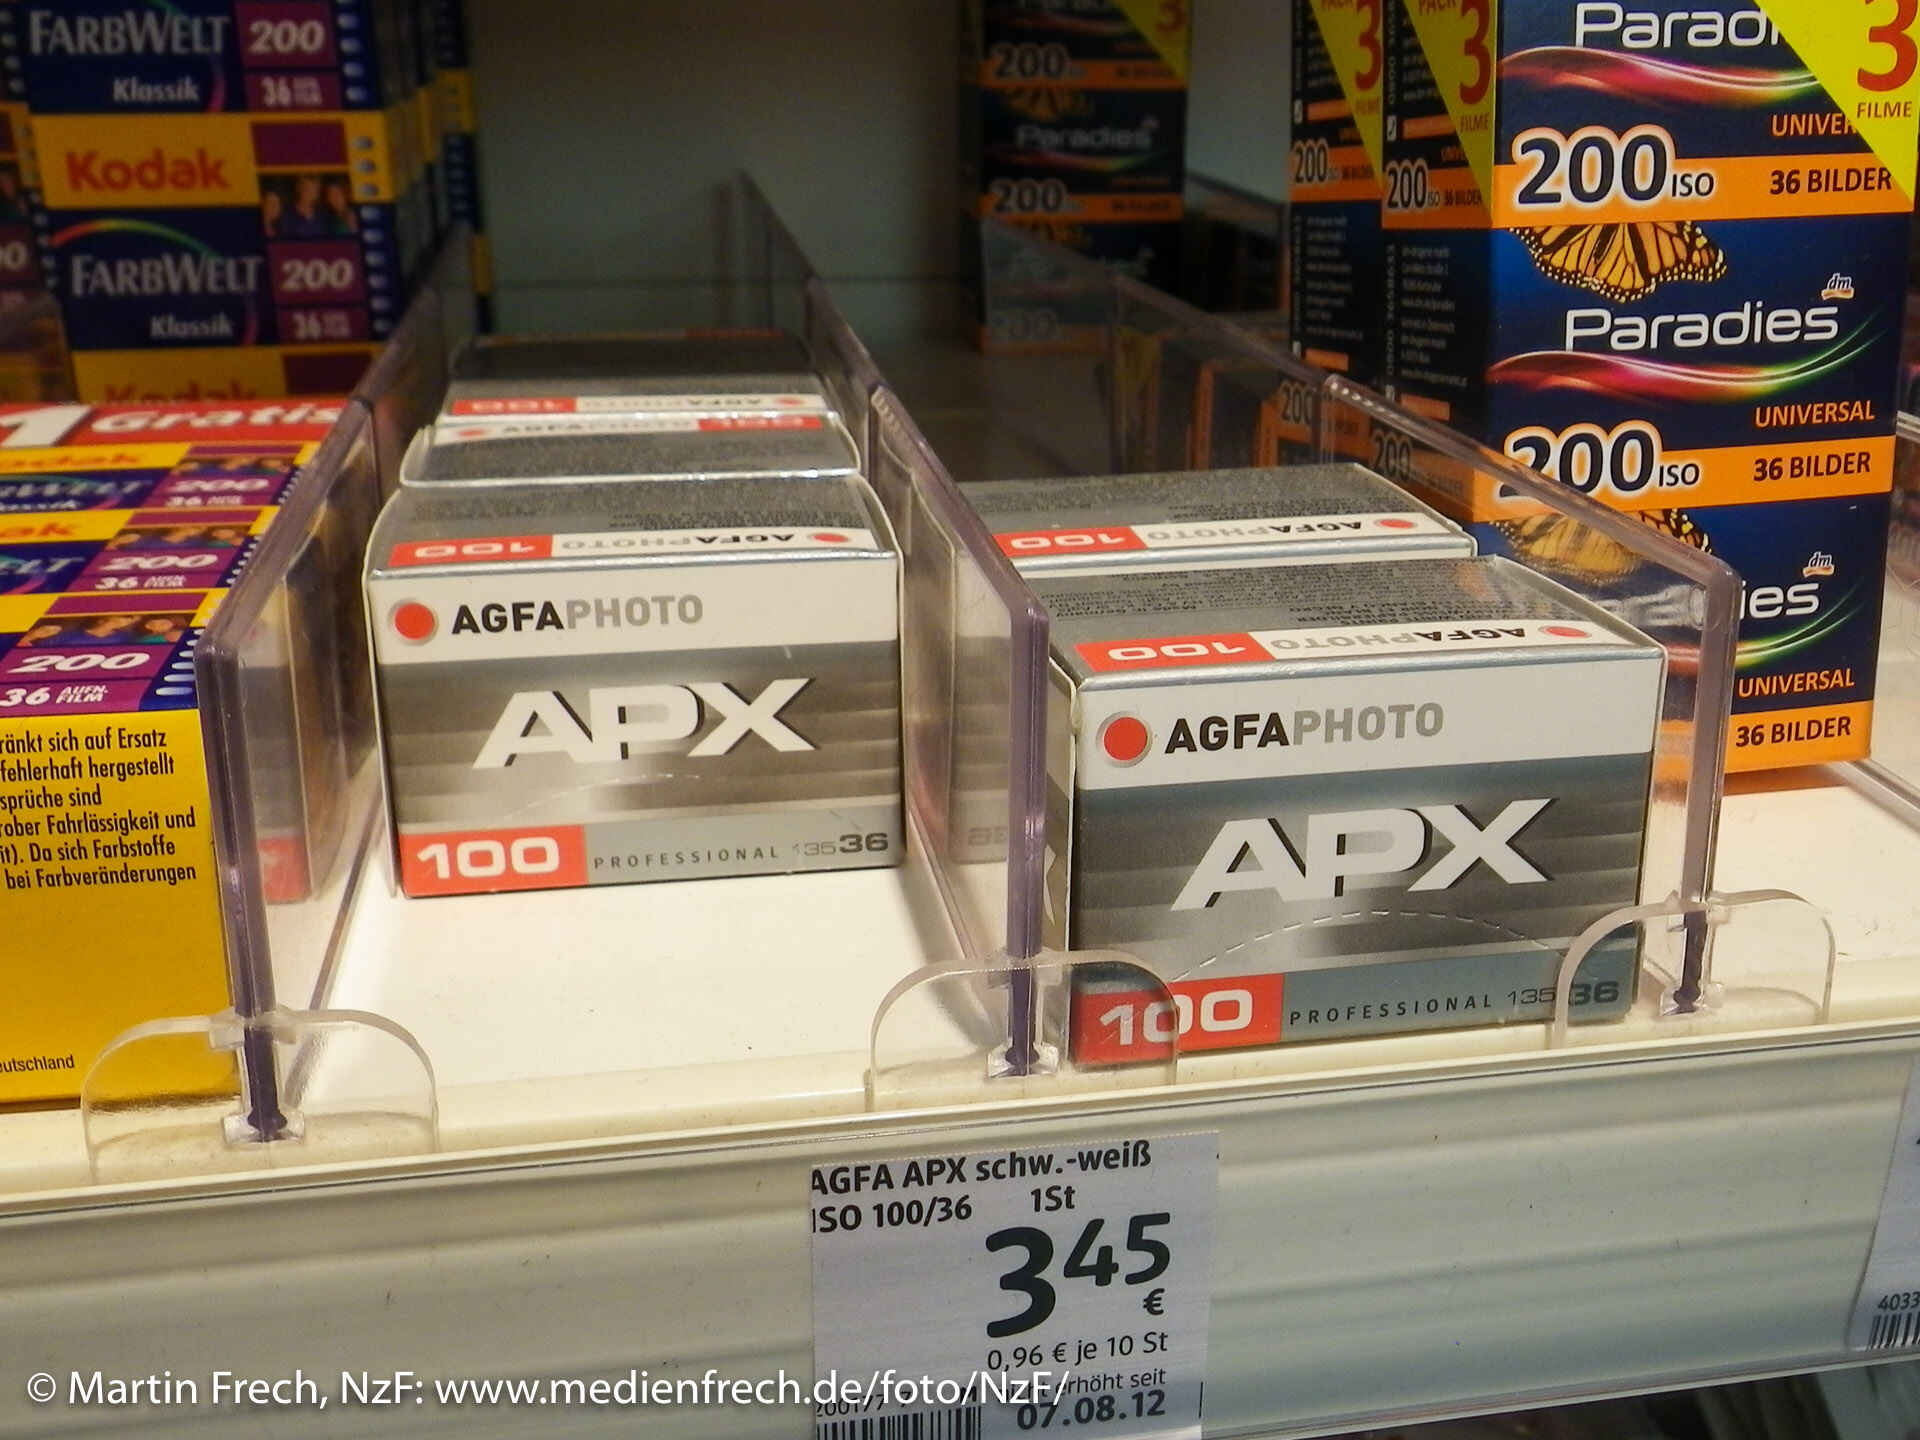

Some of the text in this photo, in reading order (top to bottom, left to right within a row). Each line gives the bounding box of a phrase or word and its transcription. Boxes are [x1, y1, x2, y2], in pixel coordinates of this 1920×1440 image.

[249, 19, 326, 54] 200
[1857, 0, 1918, 92] 3
[994, 49, 1067, 79] 200
[1459, 0, 1491, 105] 3
[113, 77, 199, 102] Klassik
[1857, 102, 1912, 119] FILME
[65, 148, 231, 192] Kodak
[1295, 144, 1328, 183] 200
[1517, 133, 1668, 204] 200
[1387, 164, 1428, 208] 200
[1671, 172, 1715, 198] ISO
[1769, 167, 1893, 195] 36 BILDER
[993, 183, 1064, 213] 200
[281, 258, 353, 290] 200
[150, 315, 233, 339] Klassik
[1565, 301, 1839, 352] Paradies
[91, 403, 344, 433] Gratis
[1755, 400, 1875, 428] UNIVERSAL
[1658, 462, 1700, 488] ISO
[1753, 452, 1871, 481] 36 BILDER
[414, 532, 794, 559] 100 AGFAPHOTO
[1011, 520, 1363, 550] 100 AGFAPHOTO
[101, 554, 218, 570] 200
[95, 576, 138, 590] 36
[452, 593, 703, 635] AGFAPHOTO
[1107, 627, 1526, 662] 100 AGFAPHOTO
[8, 653, 150, 673] 200
[4, 687, 51, 707] 36
[1738, 668, 1855, 697] UNIVERSAL
[472, 676, 822, 769] APX
[1165, 702, 1445, 756] AGFAPHOTO
[1735, 715, 1851, 747] 36 BILDER
[49, 728, 79, 752] sich
[85, 726, 112, 750] auf
[118, 728, 167, 750] Ersatz
[0, 752, 174, 783] fehlerhaft hergestellt
[0, 783, 102, 814] sprüche sind
[47, 810, 160, 838] Fahrlässigkeit
[166, 805, 196, 829] und
[29, 842, 52, 862] Da
[58, 838, 88, 861] sich
[93, 835, 176, 860] Farbstoffe
[417, 836, 560, 880] 100
[592, 845, 780, 871] PROFESSIONAL
[1170, 797, 1559, 912] APX
[5, 863, 197, 890] bei Farbveränderungen
[1099, 988, 1253, 1047] 100
[1289, 995, 1493, 1027] PROFESSIONAL
[812, 1139, 1152, 1195] AGFA APX schw.-weiß
[812, 1185, 1076, 1233] ISO 100/36 1St
[1143, 1288, 1165, 1316] €
[987, 1330, 1169, 1371] 0,96 € je 10 St
[1130, 1368, 1167, 1388] seit
[1017, 1389, 1166, 1430] 07.08.12
